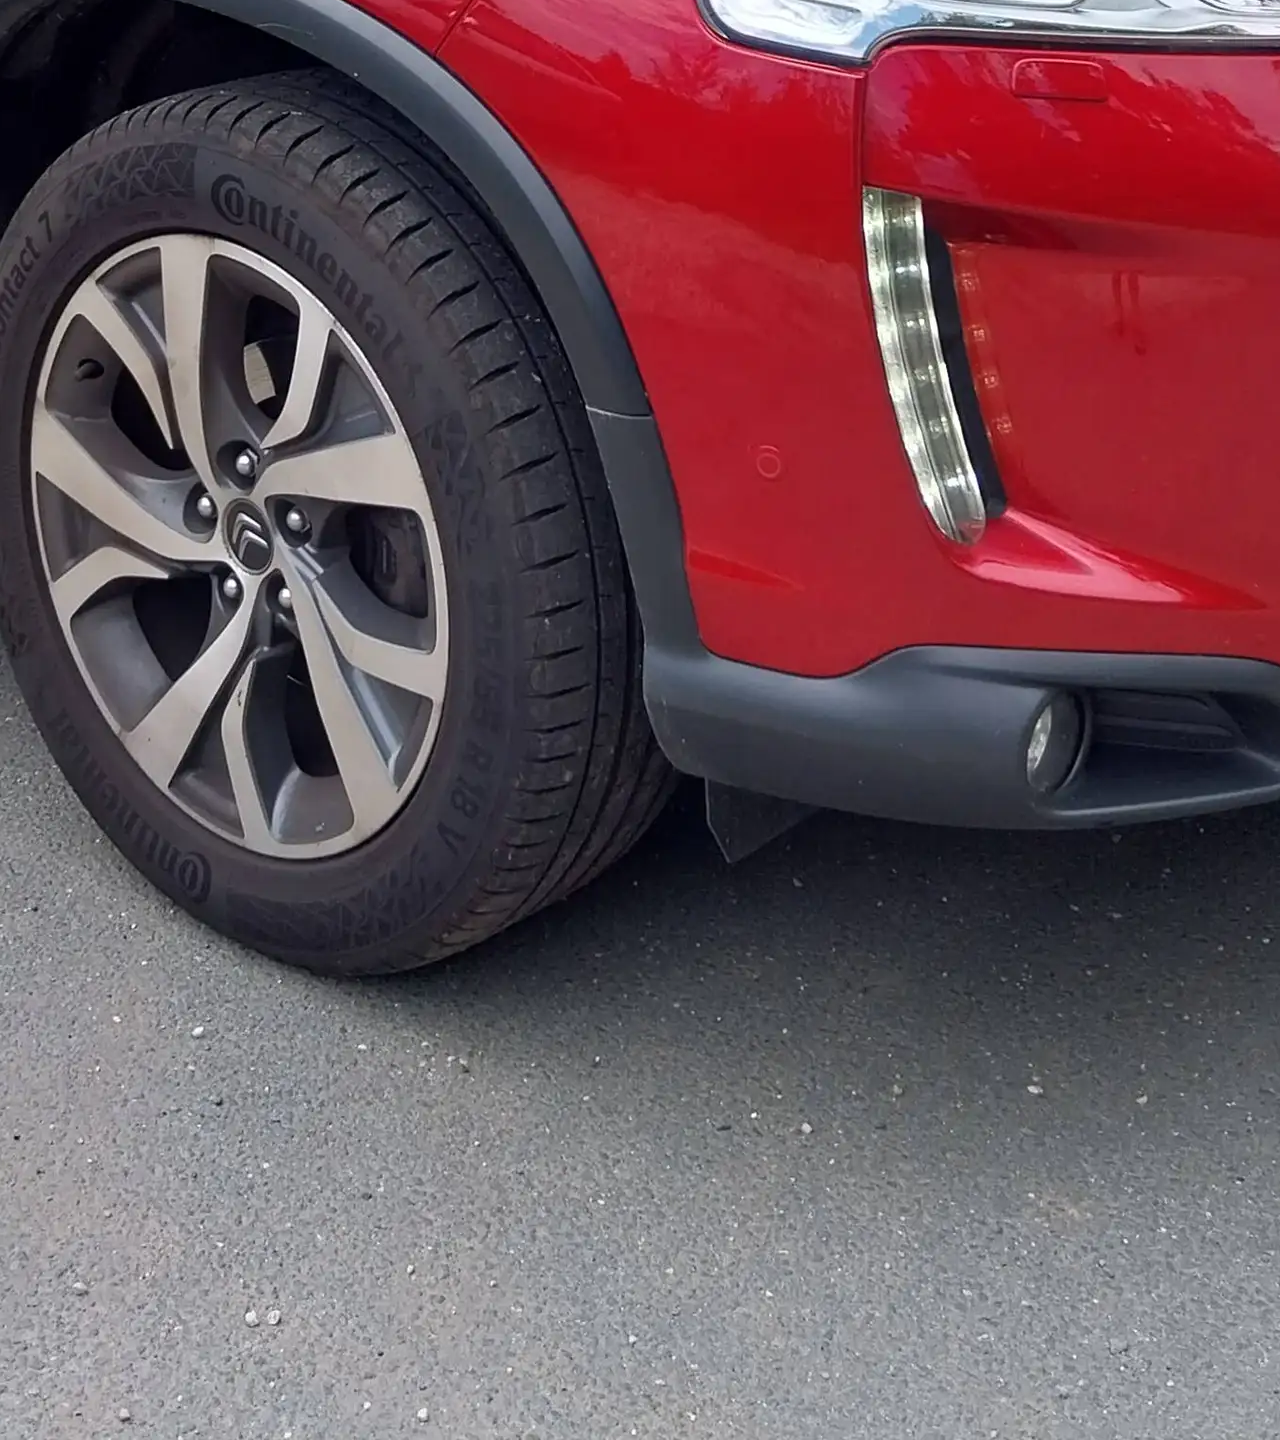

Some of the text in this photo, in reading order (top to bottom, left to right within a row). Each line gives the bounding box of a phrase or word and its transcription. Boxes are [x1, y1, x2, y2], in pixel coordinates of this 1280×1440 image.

[38, 211, 52, 243] 7
[209, 173, 405, 362] Continental
[46, 707, 213, 905] Continental
